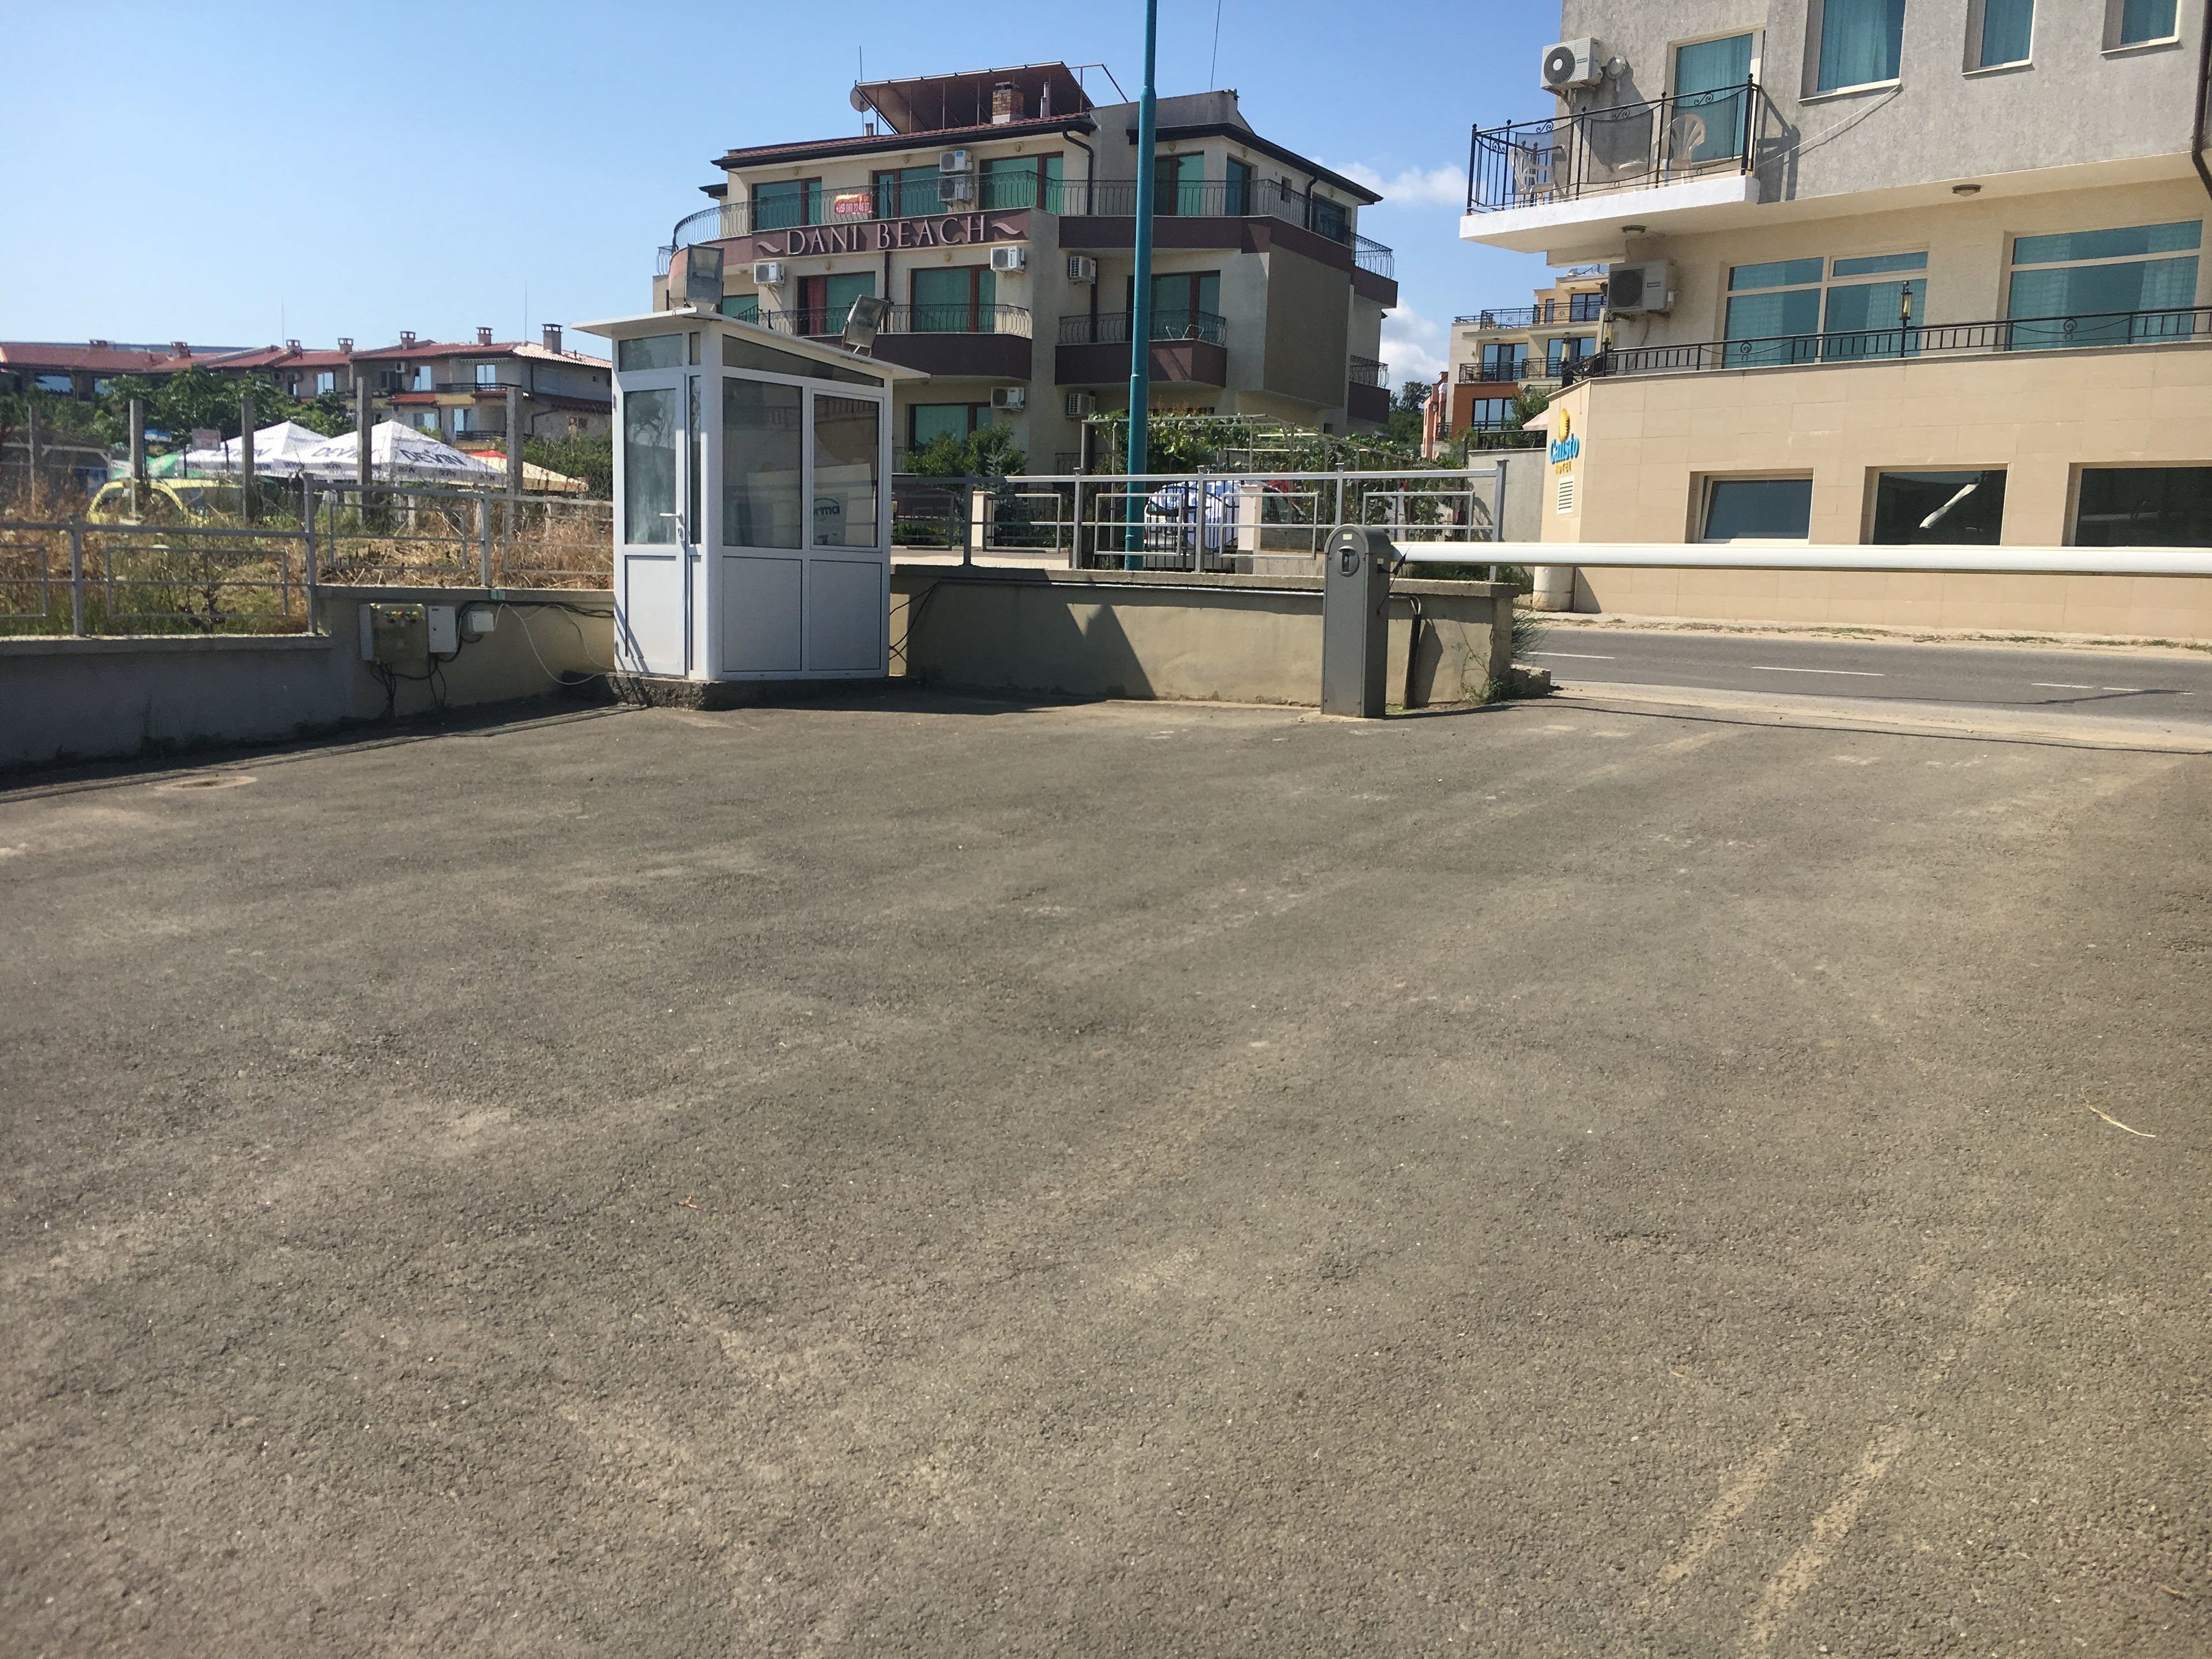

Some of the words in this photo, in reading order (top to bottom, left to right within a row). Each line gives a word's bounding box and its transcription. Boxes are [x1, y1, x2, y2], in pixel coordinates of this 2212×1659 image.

[786, 226, 858, 255] DANI
[877, 215, 986, 248] BEACH
[399, 449, 467, 466] DEVIN
